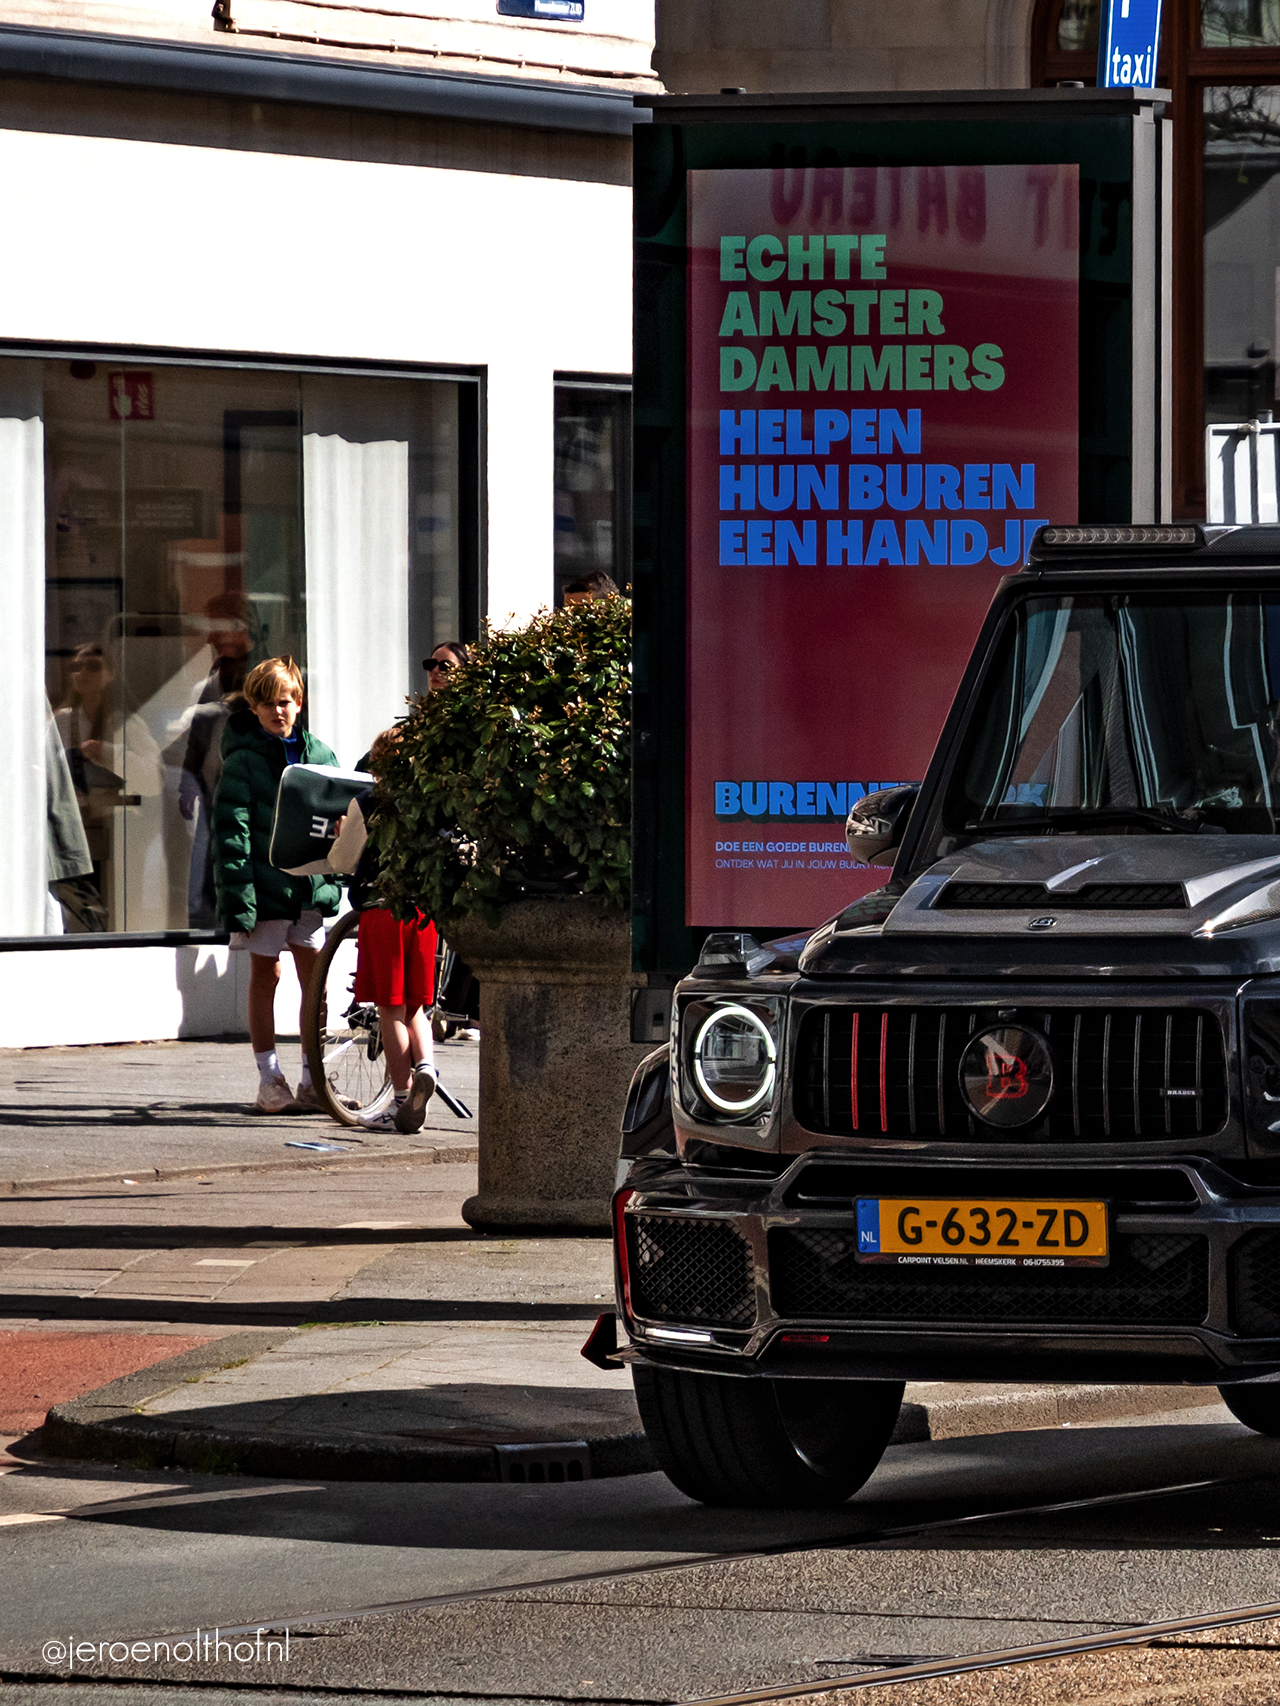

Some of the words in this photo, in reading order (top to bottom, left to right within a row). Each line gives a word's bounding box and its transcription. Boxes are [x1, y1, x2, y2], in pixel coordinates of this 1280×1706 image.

[1112, 45, 1151, 84] taxi
[719, 234, 887, 282] ECHTE
[718, 289, 946, 336] AMSTER
[719, 343, 1006, 391] DAMMERS
[719, 408, 922, 455] HELPEN
[719, 464, 839, 511] HUN
[848, 463, 1035, 511] BUREN
[719, 520, 817, 566] EEN
[715, 842, 739, 852] DOE
[742, 842, 764, 852] EEN
[766, 842, 806, 852] GOEDE
[808, 842, 851, 852] BUREN
[715, 859, 754, 869] ONTDEK
[757, 859, 779, 869] WAT
[781, 859, 794, 869] JIJ
[795, 859, 805, 869] IN
[807, 859, 837, 869] JOUW
[861, 1231, 877, 1243] NL
[897, 1206, 1090, 1248] G-632-ZD
[898, 1256, 932, 1264] CARPOINT
[975, 1258, 1016, 1266] HEEMSKERK
